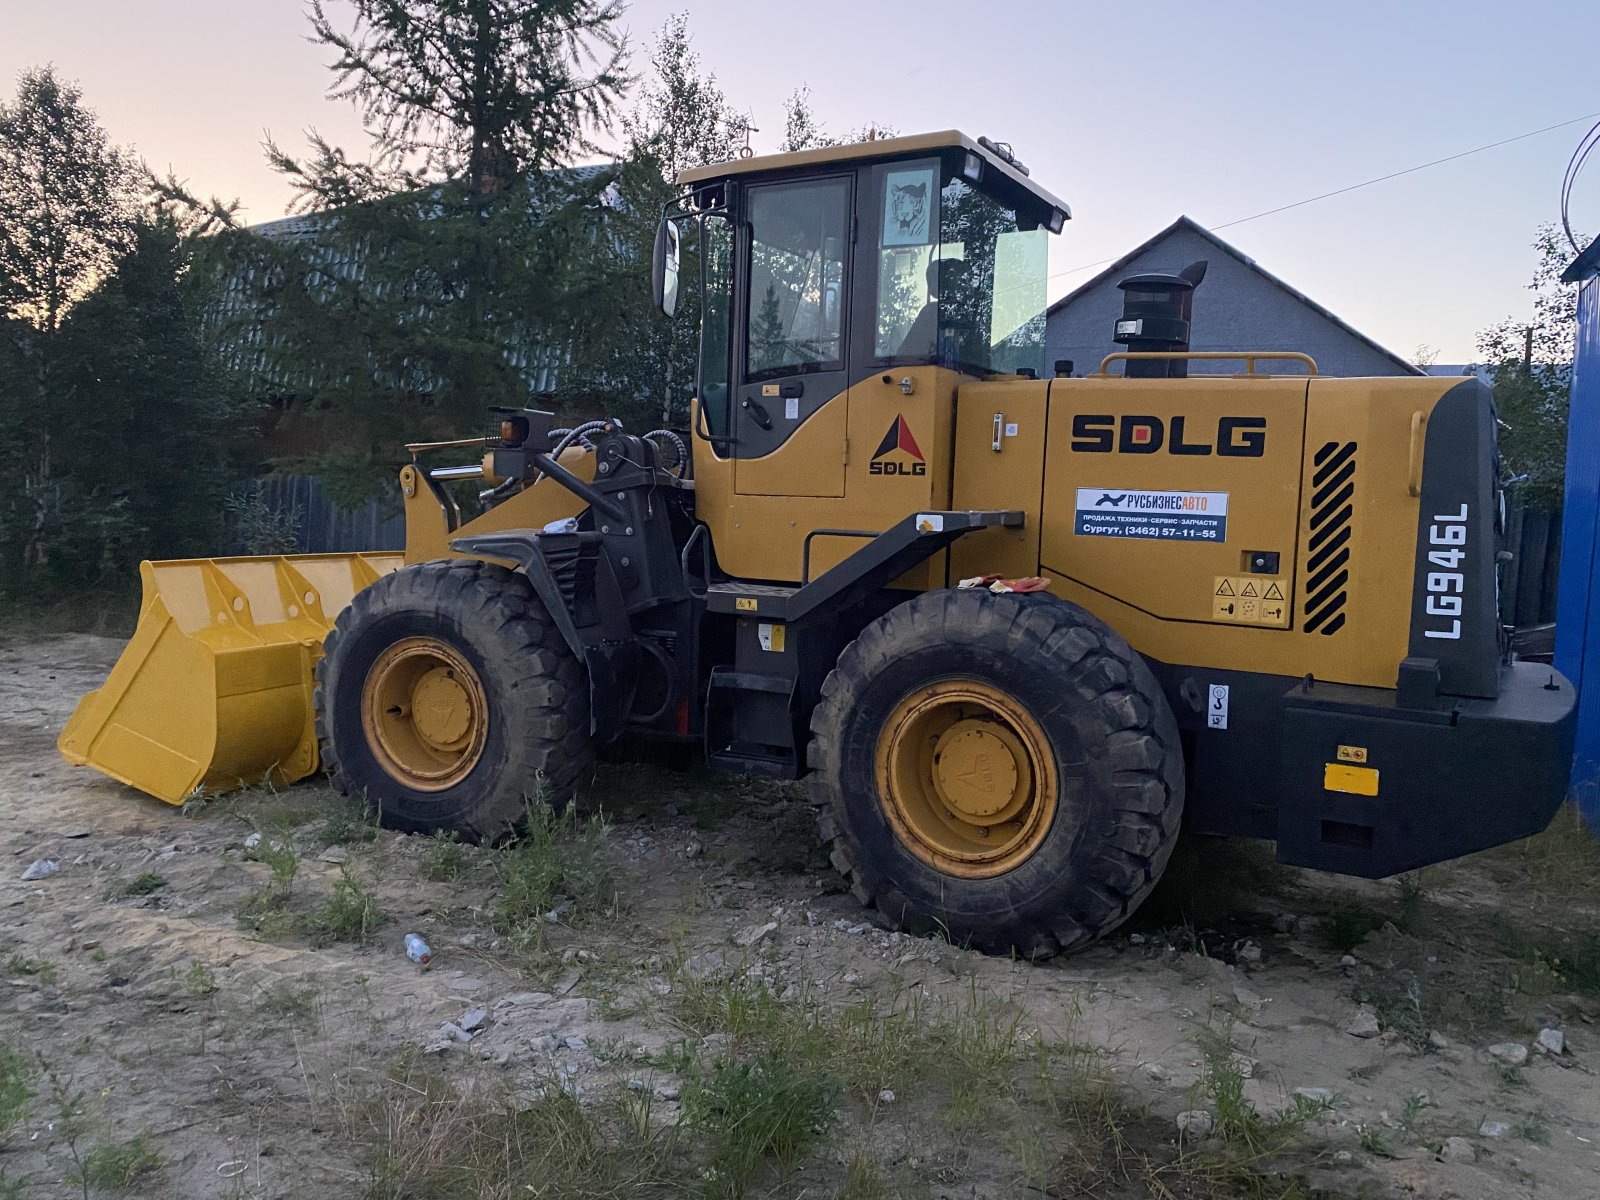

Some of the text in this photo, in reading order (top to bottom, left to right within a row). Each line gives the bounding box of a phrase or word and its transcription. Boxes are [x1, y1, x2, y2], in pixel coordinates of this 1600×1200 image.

[1071, 414, 1267, 457] SDLG
[869, 461, 926, 476] SDLG
[1127, 494, 1208, 511] РУСБИЗНЕСАВТО
[1083, 514, 1116, 522] ПРОДАЖА
[1083, 524, 1217, 538] Сургут, (3462) 57-11-55
[1424, 503, 1468, 640] LG946L
